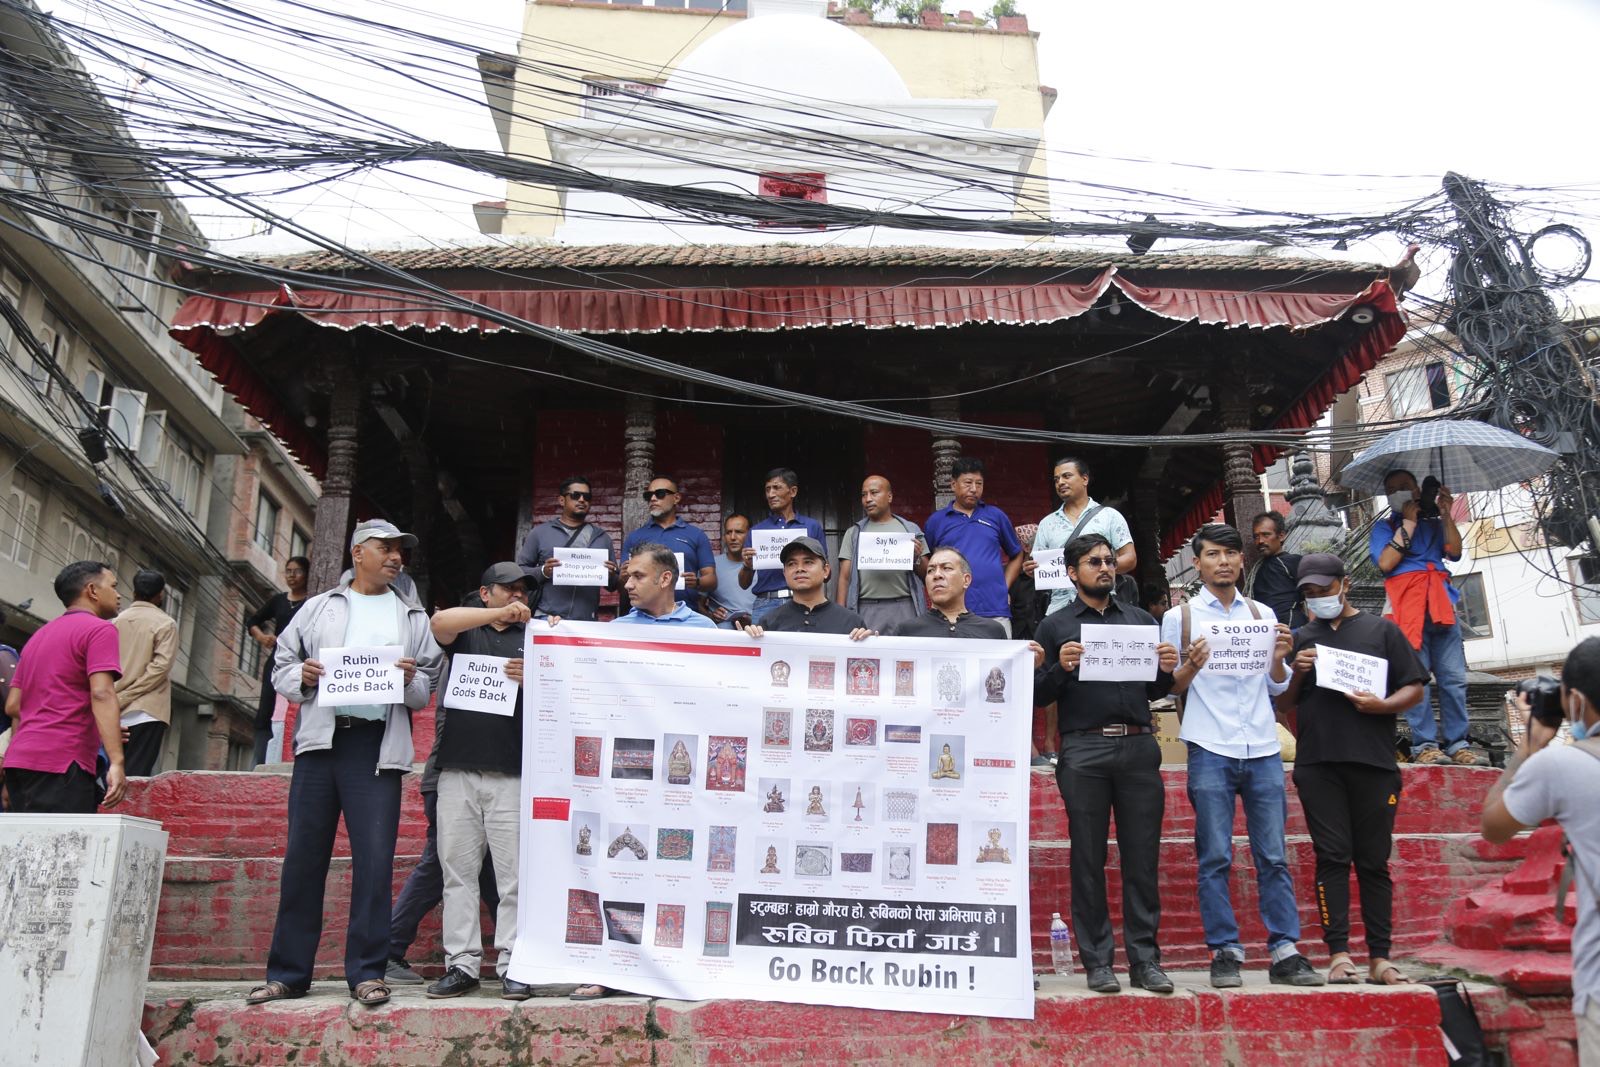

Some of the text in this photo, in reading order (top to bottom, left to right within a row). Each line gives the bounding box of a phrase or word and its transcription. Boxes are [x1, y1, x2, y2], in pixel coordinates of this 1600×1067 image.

[876, 537, 888, 547] Say
[1211, 625, 1219, 634] $
[343, 655, 379, 665] Rubin
[334, 668, 388, 679] Give Our
[468, 662, 498, 674] Rubin
[327, 681, 394, 693] Gods Back
[460, 674, 504, 688] Give Our
[452, 687, 507, 702] Gods Back
[796, 900, 820, 917] हाम्रो
[822, 900, 849, 918] गौरव
[915, 904, 936, 922] पैसा
[939, 906, 982, 924] अभिसाप
[985, 908, 997, 925] हो
[846, 925, 917, 949] फिर्ता
[925, 931, 981, 952] जाउँ
[769, 956, 976, 991] Go Back Rubin !
